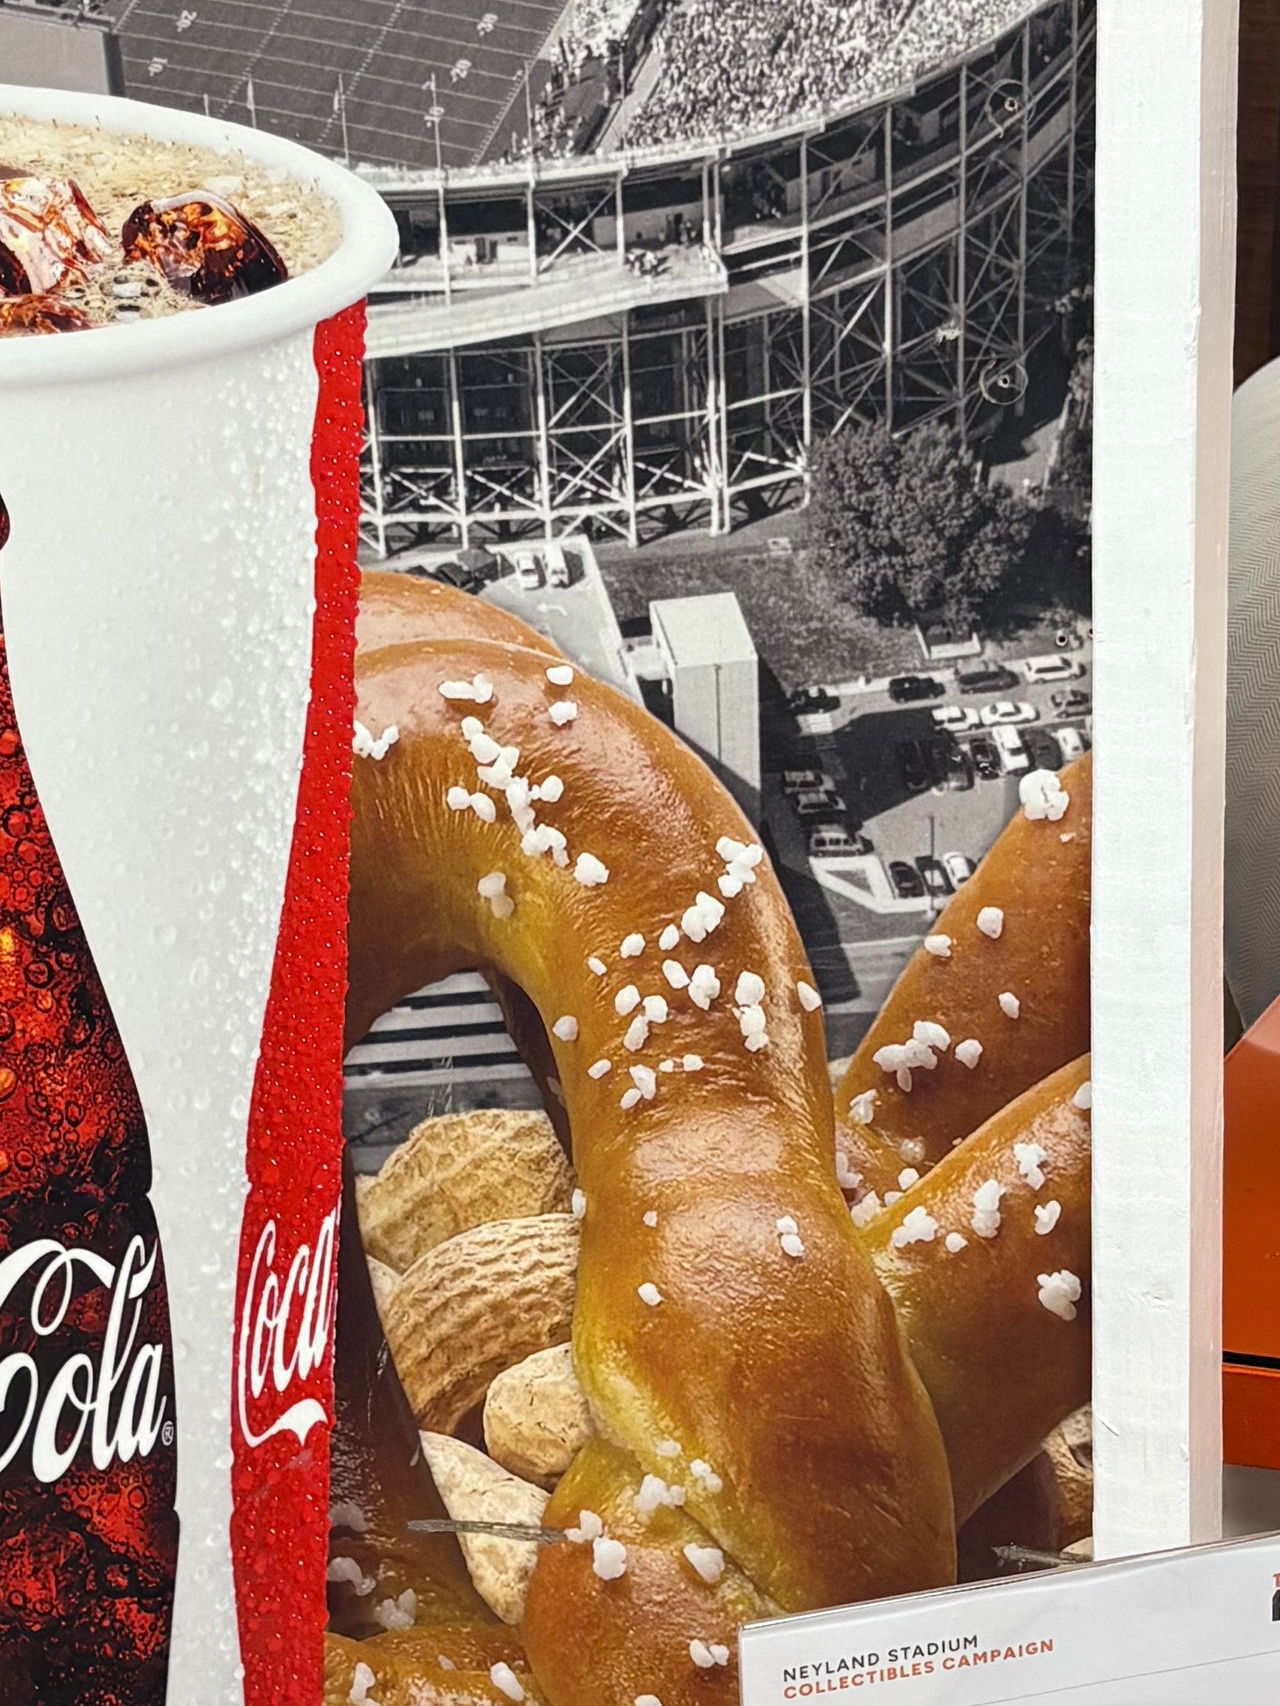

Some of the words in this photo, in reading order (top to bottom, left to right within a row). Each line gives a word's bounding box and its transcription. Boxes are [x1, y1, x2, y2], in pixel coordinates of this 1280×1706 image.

[782, 1660, 935, 1700] COLLECTIBLES
[941, 1638, 1054, 1671] CAMPAIGN
[783, 1652, 881, 1683] NEYLAND
[887, 1633, 979, 1664] STADIUM
